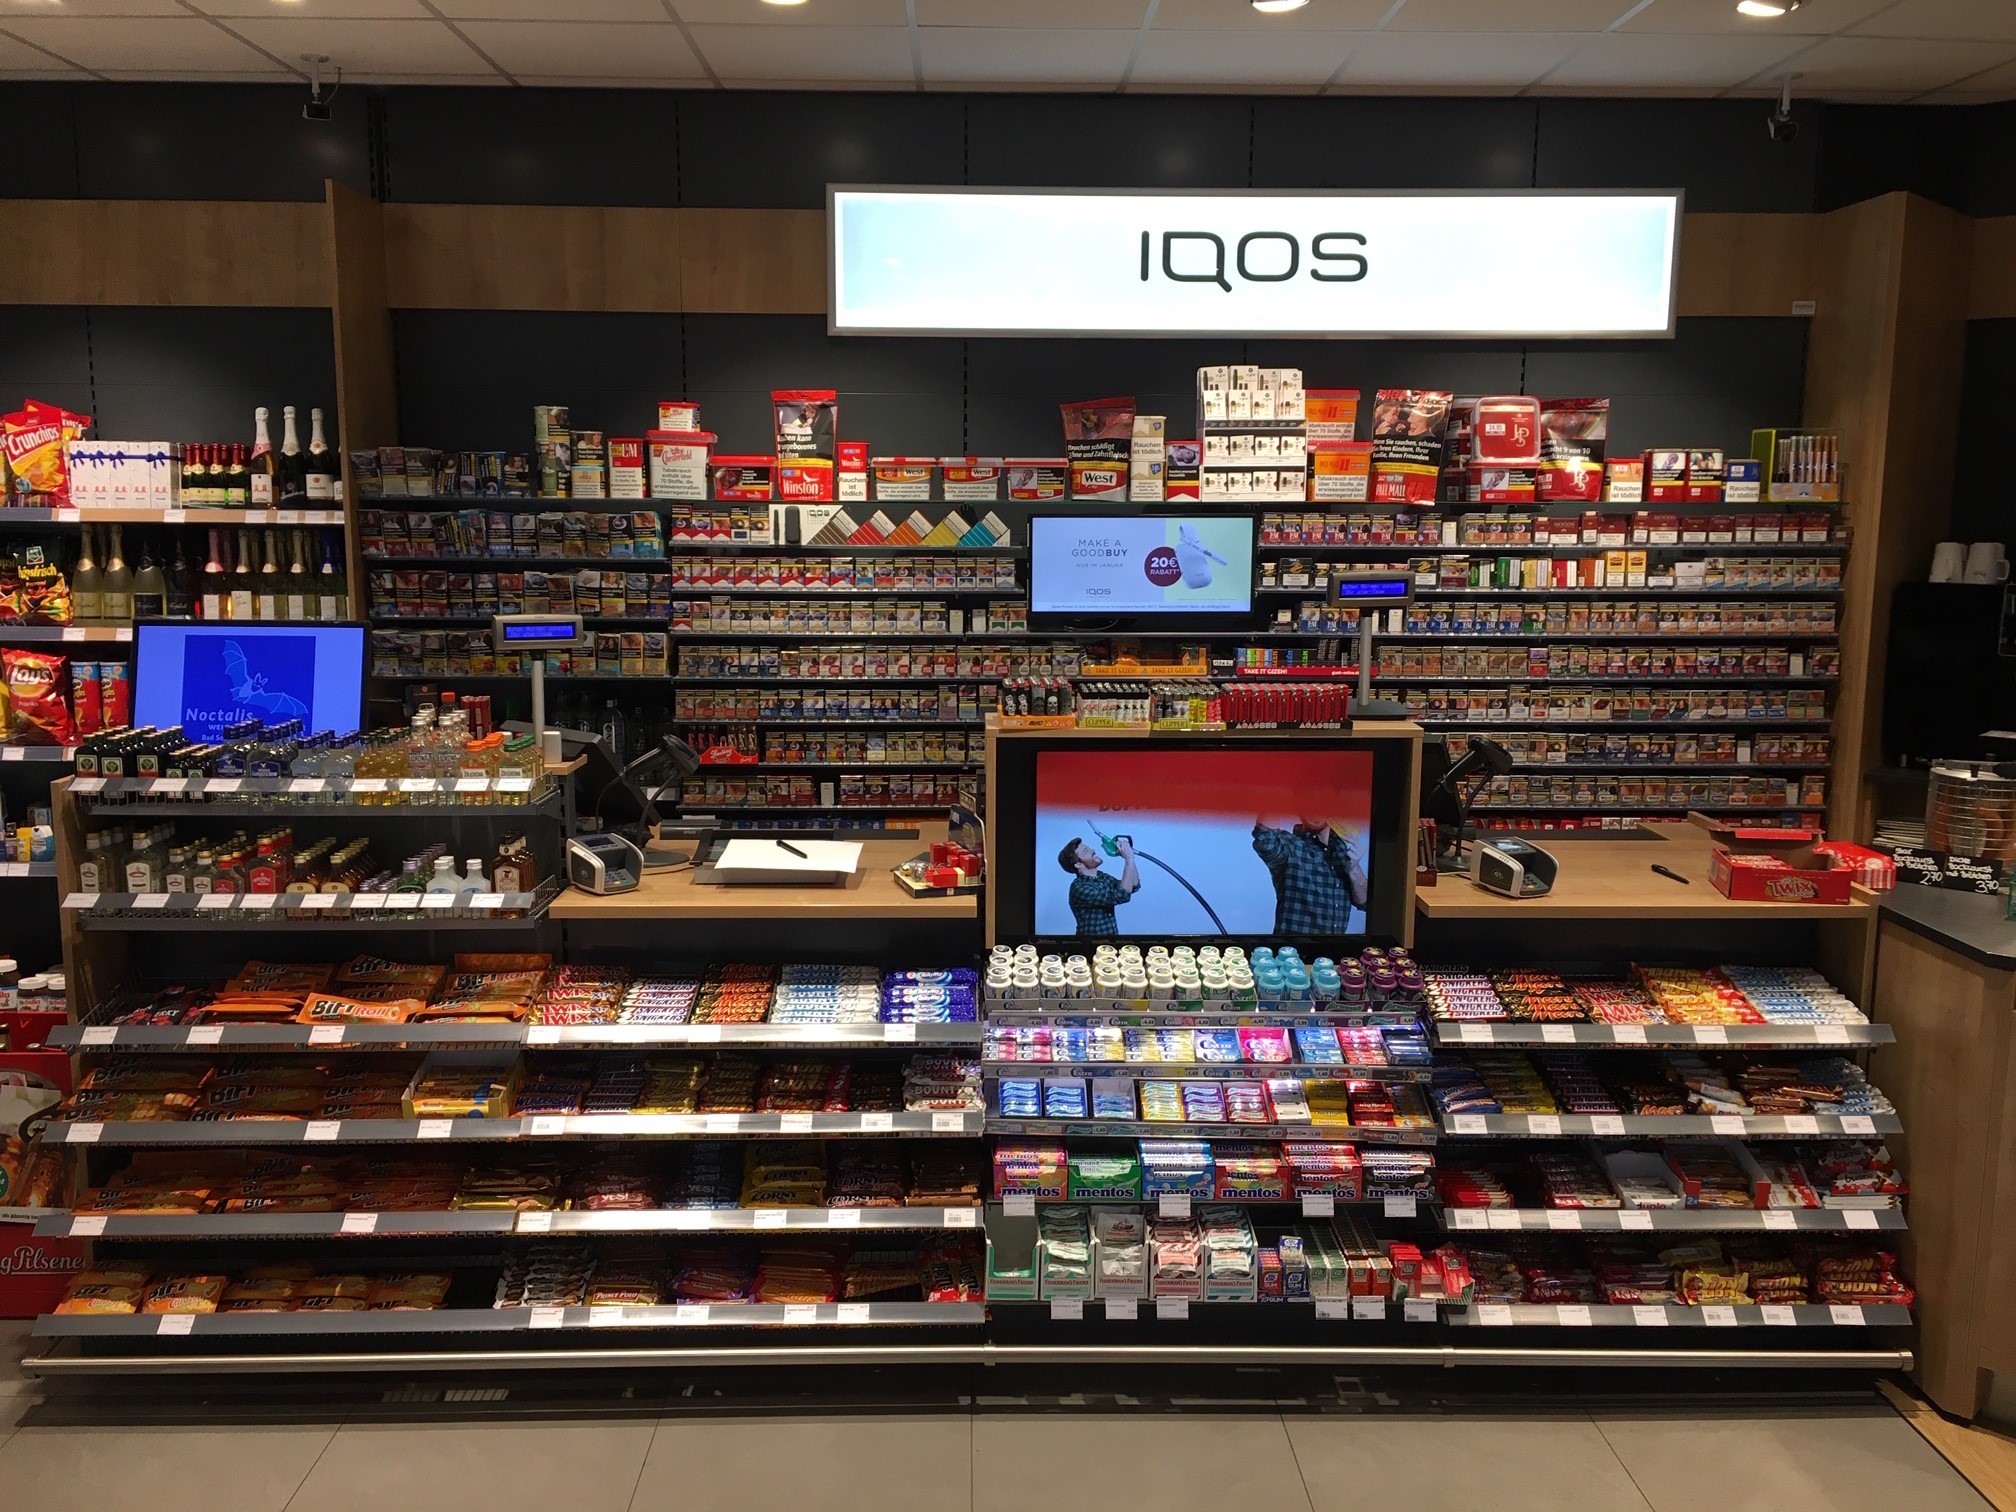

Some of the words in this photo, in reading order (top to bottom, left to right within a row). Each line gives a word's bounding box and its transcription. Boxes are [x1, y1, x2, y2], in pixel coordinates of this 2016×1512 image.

[1140, 230, 1369, 292] IQOS
[8, 426, 61, 455] Crunchips
[1085, 472, 1115, 484] West
[783, 479, 819, 495] Winston
[1078, 539, 1110, 547] MAKE
[1114, 539, 1121, 547] A
[1072, 549, 1128, 557] GOODBUY
[1150, 557, 1178, 568] 20€
[1085, 588, 1111, 596] IQOS
[185, 708, 254, 722] Noctalis
[1451, 1003, 1501, 1011] SNICKERS
[1845, 1171, 1874, 1183] bueno
[601, 1193, 629, 1201] YES!
[752, 1191, 797, 1201] CORNY
[1001, 1187, 1060, 1197] mentos
[1075, 1187, 1134, 1197] mentos
[1150, 1187, 1208, 1197] mentos
[1222, 1188, 1280, 1198] mentos
[1296, 1188, 1354, 1198] mentos
[1369, 1188, 1428, 1198] mentos
